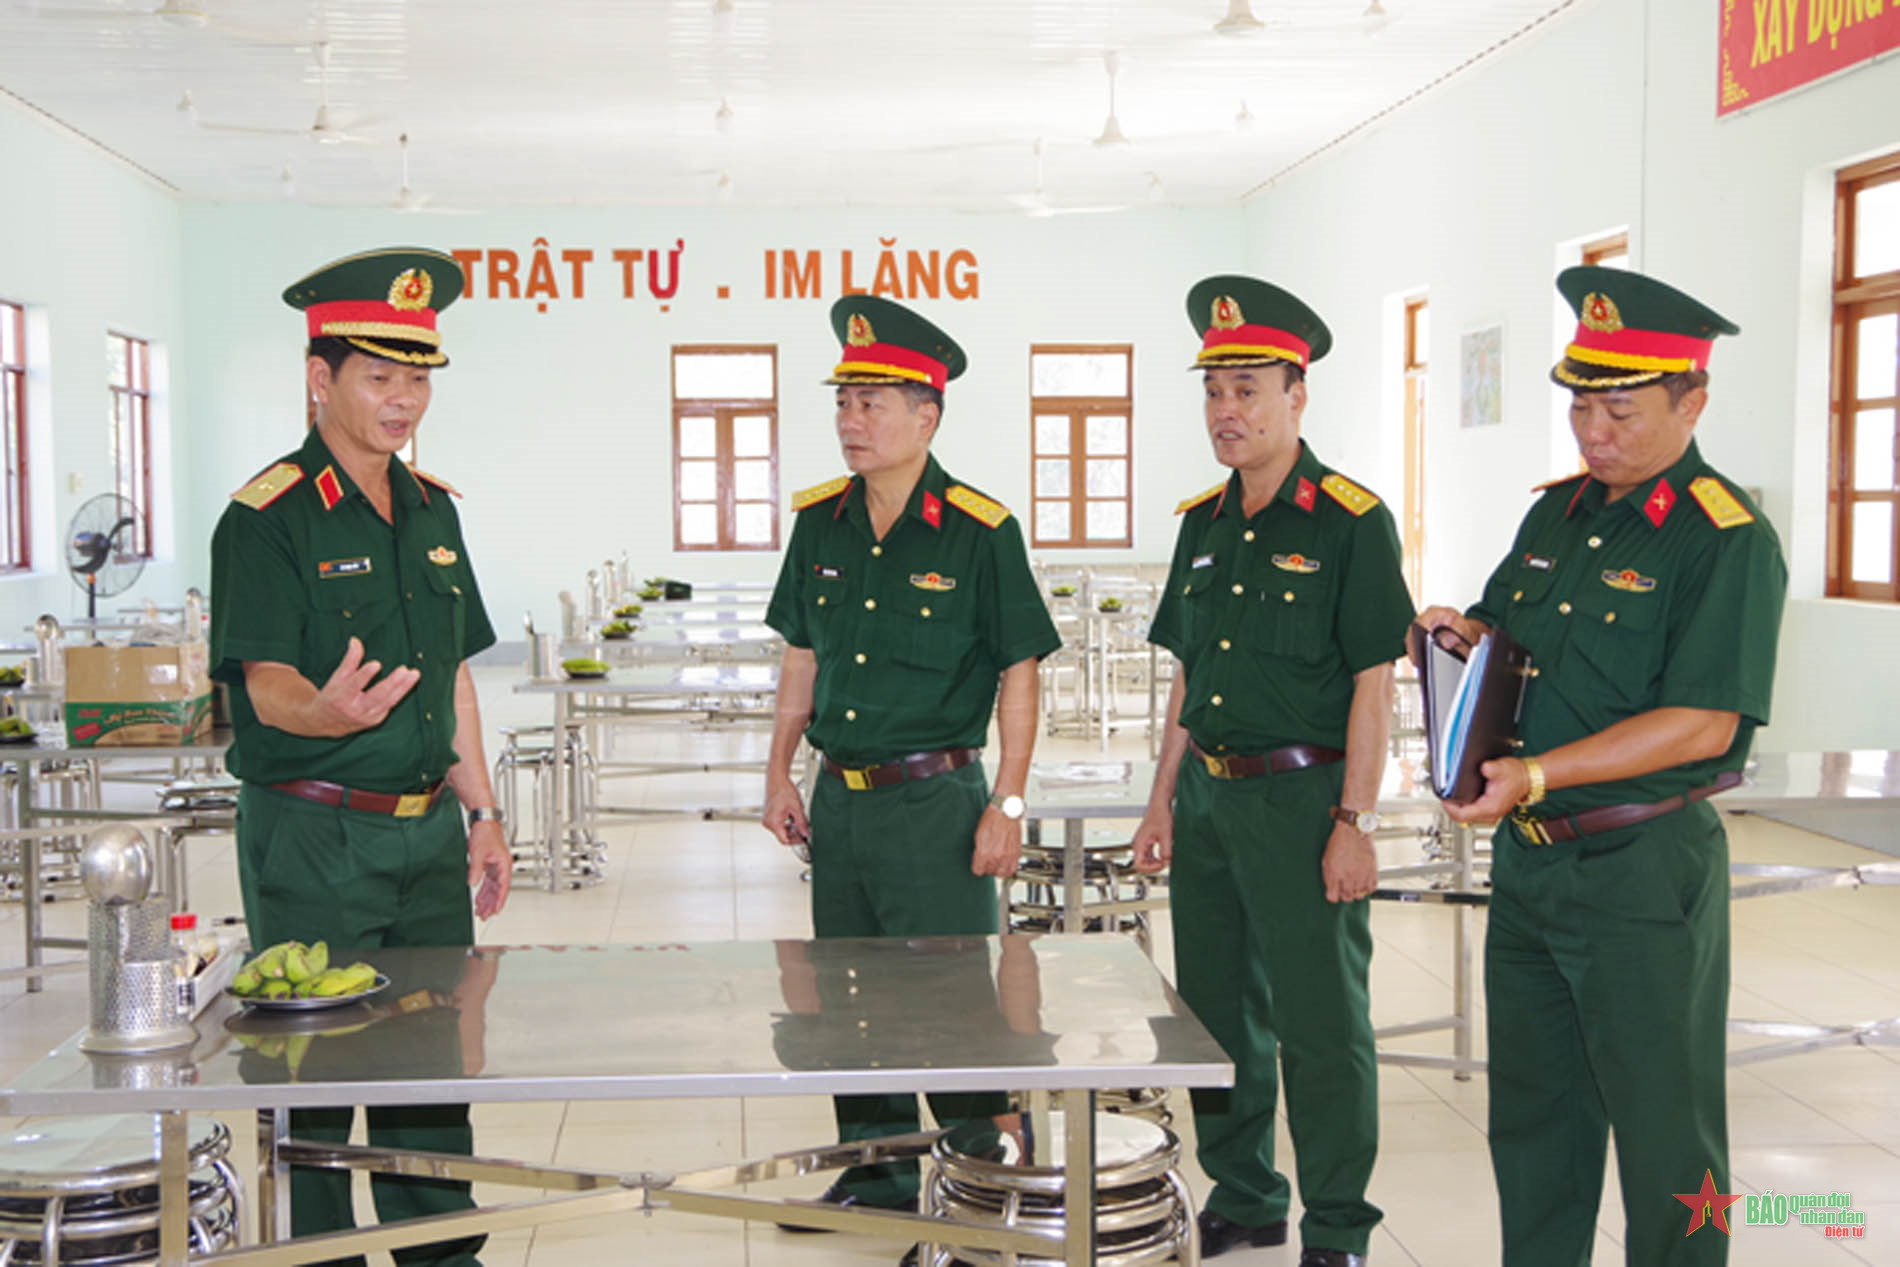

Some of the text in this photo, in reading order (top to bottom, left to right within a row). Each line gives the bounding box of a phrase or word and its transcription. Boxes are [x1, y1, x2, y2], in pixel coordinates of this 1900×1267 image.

[450, 237, 593, 312] TRẬT
[613, 238, 684, 312] TỰ
[764, 249, 821, 299] IM
[841, 237, 980, 300] LĂNG
